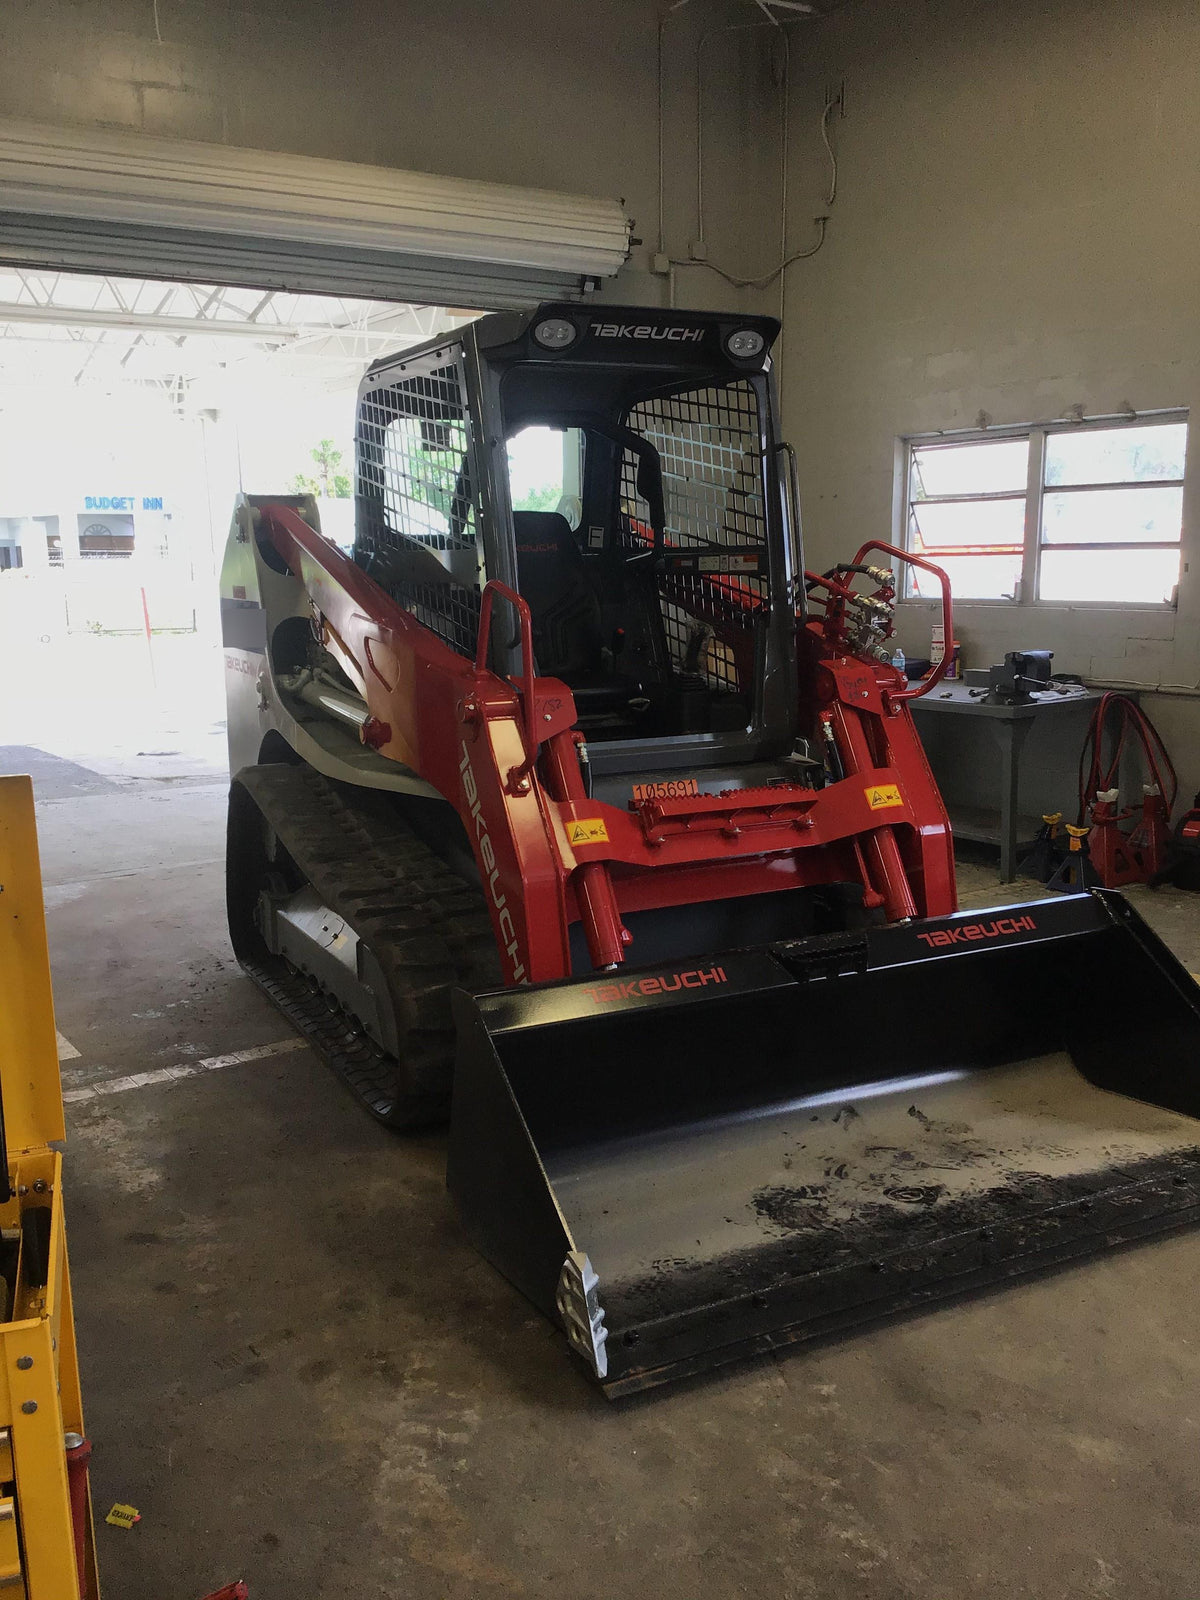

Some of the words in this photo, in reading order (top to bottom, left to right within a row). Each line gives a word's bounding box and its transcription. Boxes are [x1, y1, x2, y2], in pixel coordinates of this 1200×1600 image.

[590, 323, 705, 342] TAKEUCHI
[84, 496, 135, 510] BUDGET
[142, 497, 163, 510] INN
[635, 779, 697, 800] 105691
[916, 916, 1037, 948] TAKEUCHI
[583, 966, 728, 1004] TAKEUCHI
